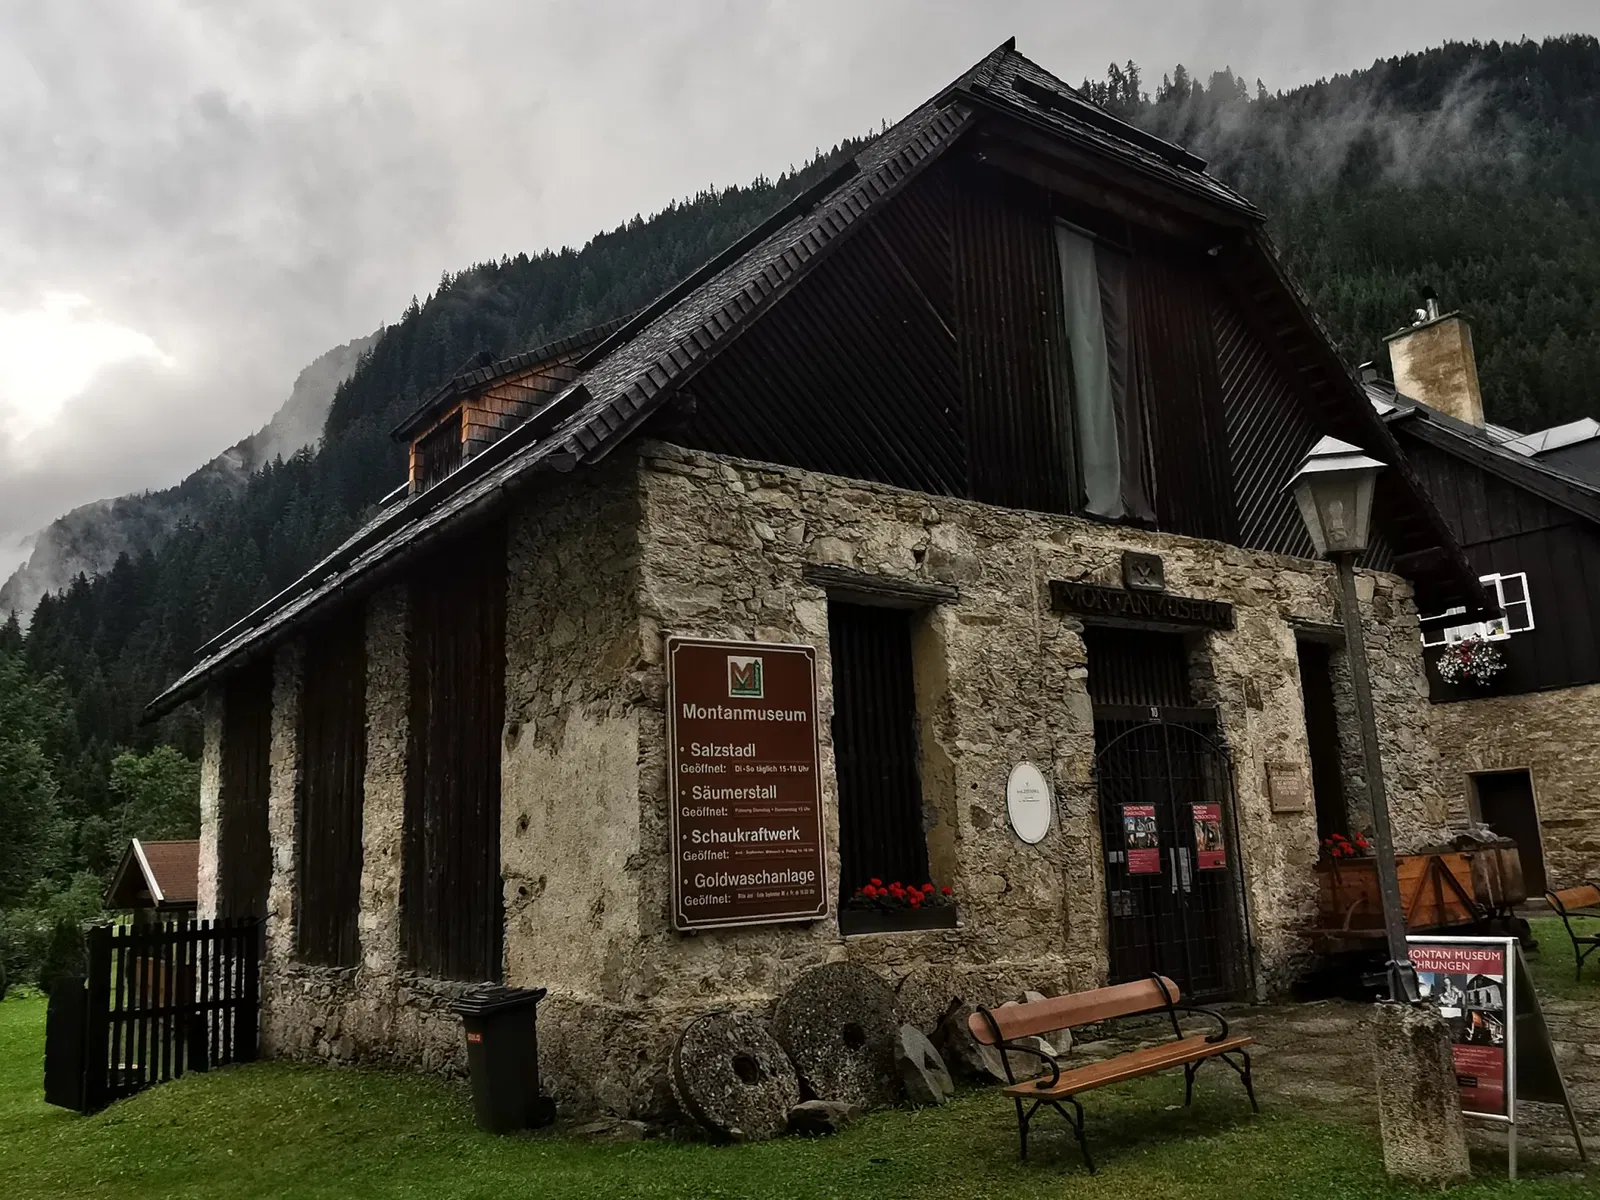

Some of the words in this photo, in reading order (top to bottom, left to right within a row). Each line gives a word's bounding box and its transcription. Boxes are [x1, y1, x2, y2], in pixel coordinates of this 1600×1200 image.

[682, 703, 807, 722] Montanmuseum
[690, 742, 756, 757] Salzstadl
[680, 763, 727, 774] Geöffnet:
[756, 765, 778, 774] täglich
[692, 785, 777, 800] Säumerstall
[681, 806, 728, 818] Geöffnet:
[691, 826, 801, 844] Schaukraftwerk
[682, 850, 730, 862] Geöffnet:
[694, 868, 815, 889] Goldwaschanlage
[684, 894, 731, 906] Geöffnet:
[1454, 951, 1501, 961] MUSEUM
